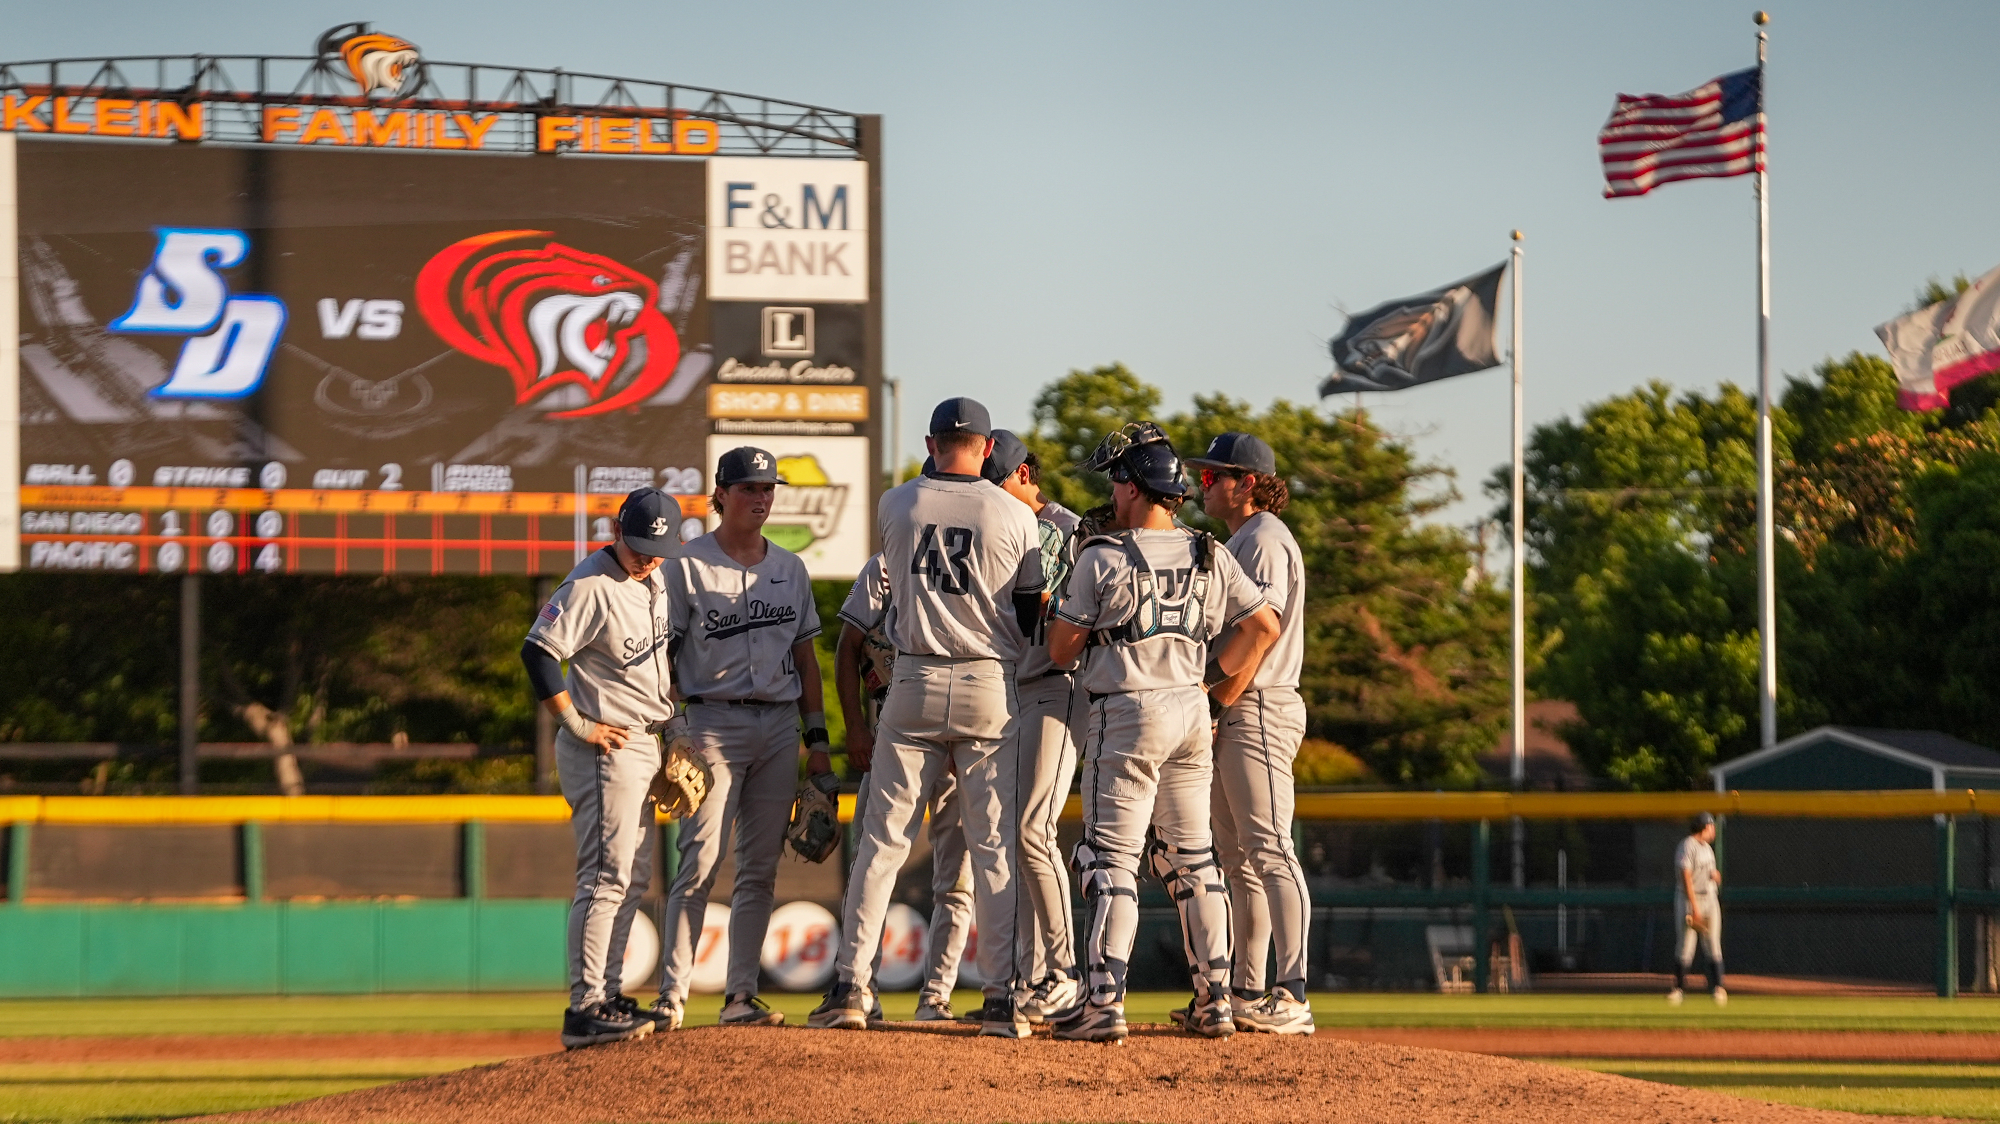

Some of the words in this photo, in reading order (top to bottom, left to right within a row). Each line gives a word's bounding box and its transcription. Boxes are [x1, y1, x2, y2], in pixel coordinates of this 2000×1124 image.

[2, 95, 204, 140] KLEIN
[263, 107, 499, 150] FAMILY
[537, 116, 720, 154] FIELD
[725, 182, 850, 230] F&M
[725, 240, 851, 276] BANK
[317, 298, 405, 340] VS
[717, 391, 781, 413] SHOP
[784, 391, 802, 413] &
[807, 392, 863, 413] DINE
[25, 463, 97, 486] BALL
[152, 466, 250, 488] STRIKE
[313, 468, 369, 490] OUT
[378, 463, 403, 492] 2
[22, 511, 69, 534] SAN
[70, 512, 142, 535] DIEGO
[160, 509, 184, 537] 1
[207, 509, 234, 538] 0
[256, 509, 283, 538] 0
[30, 541, 136, 570] PACIFIC
[157, 541, 184, 573] 0
[207, 541, 234, 572] 0
[255, 542, 282, 573] 4
[911, 523, 972, 595] 43
[705, 609, 741, 631] San
[750, 600, 796, 625] Diego
[623, 637, 649, 660] San
[655, 616, 669, 640] Die
[774, 924, 832, 964] 18
